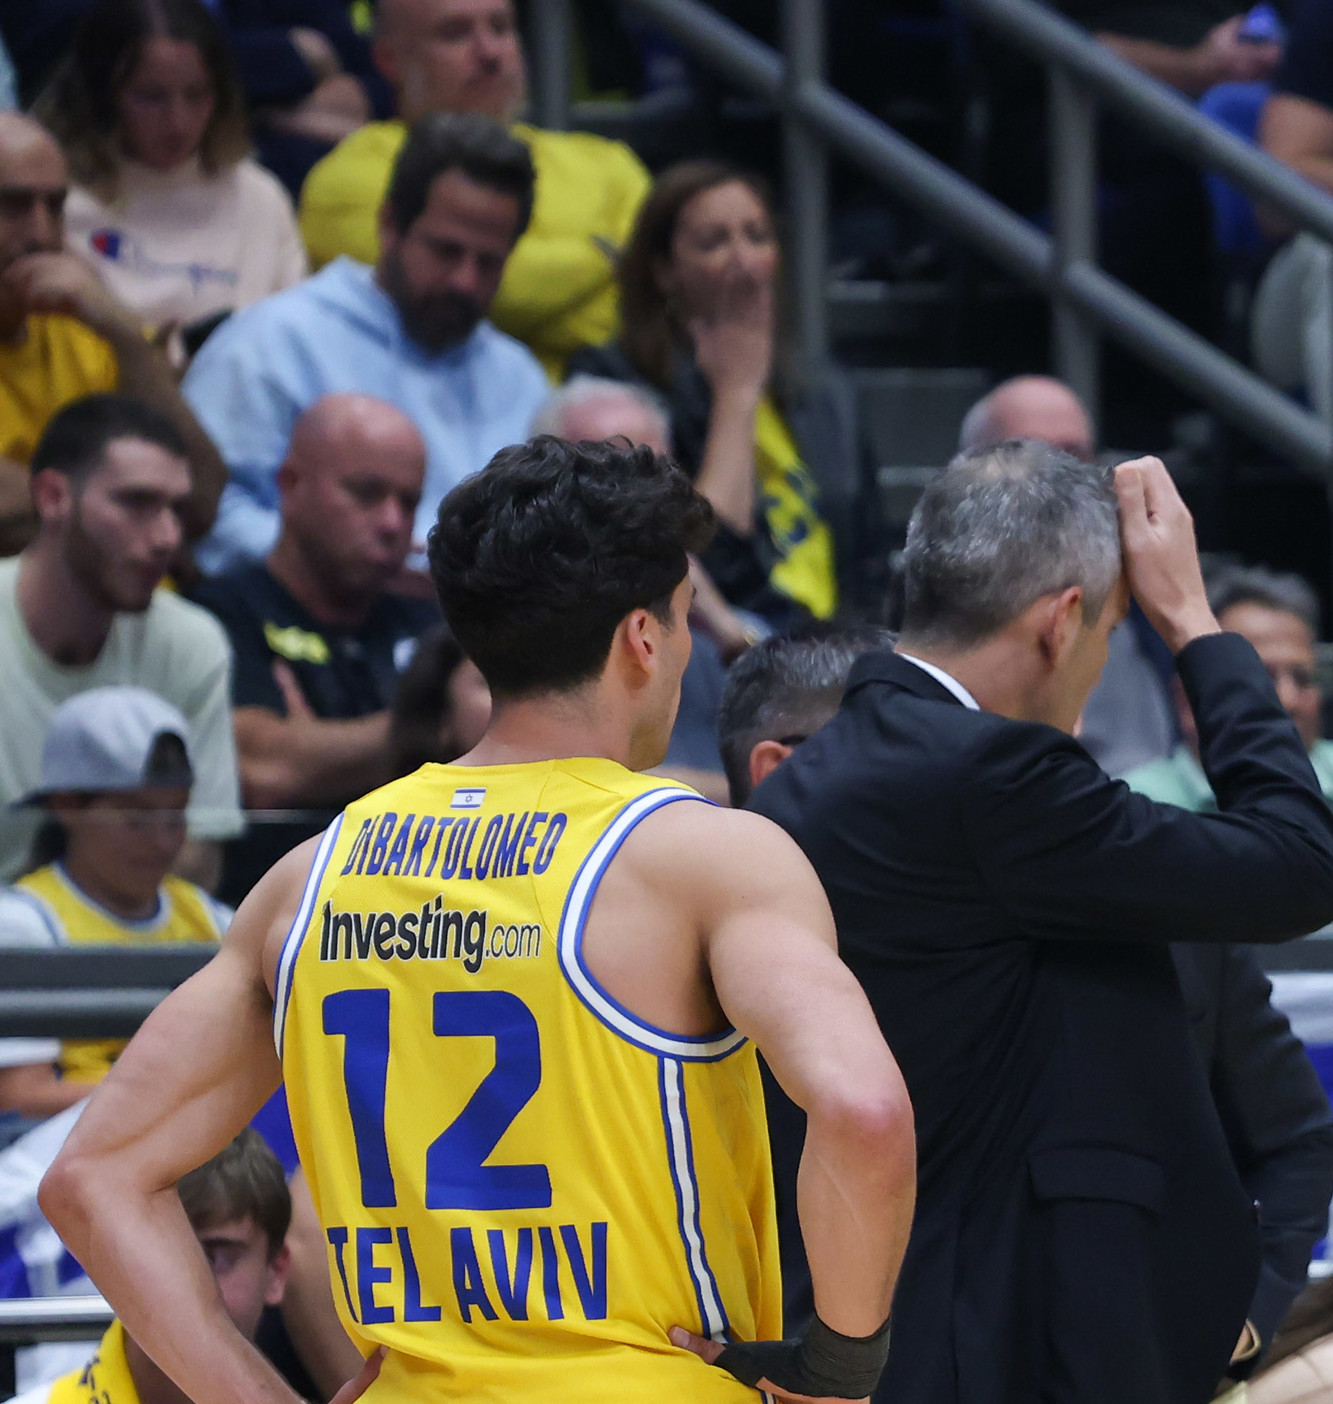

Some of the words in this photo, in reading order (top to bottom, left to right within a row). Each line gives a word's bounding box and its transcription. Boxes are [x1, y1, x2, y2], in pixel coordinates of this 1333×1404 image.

[319, 892, 542, 975] Investing.com
[322, 988, 553, 1211] 12
[326, 1225, 442, 1325] TEL
[450, 1221, 609, 1324] AVIV
